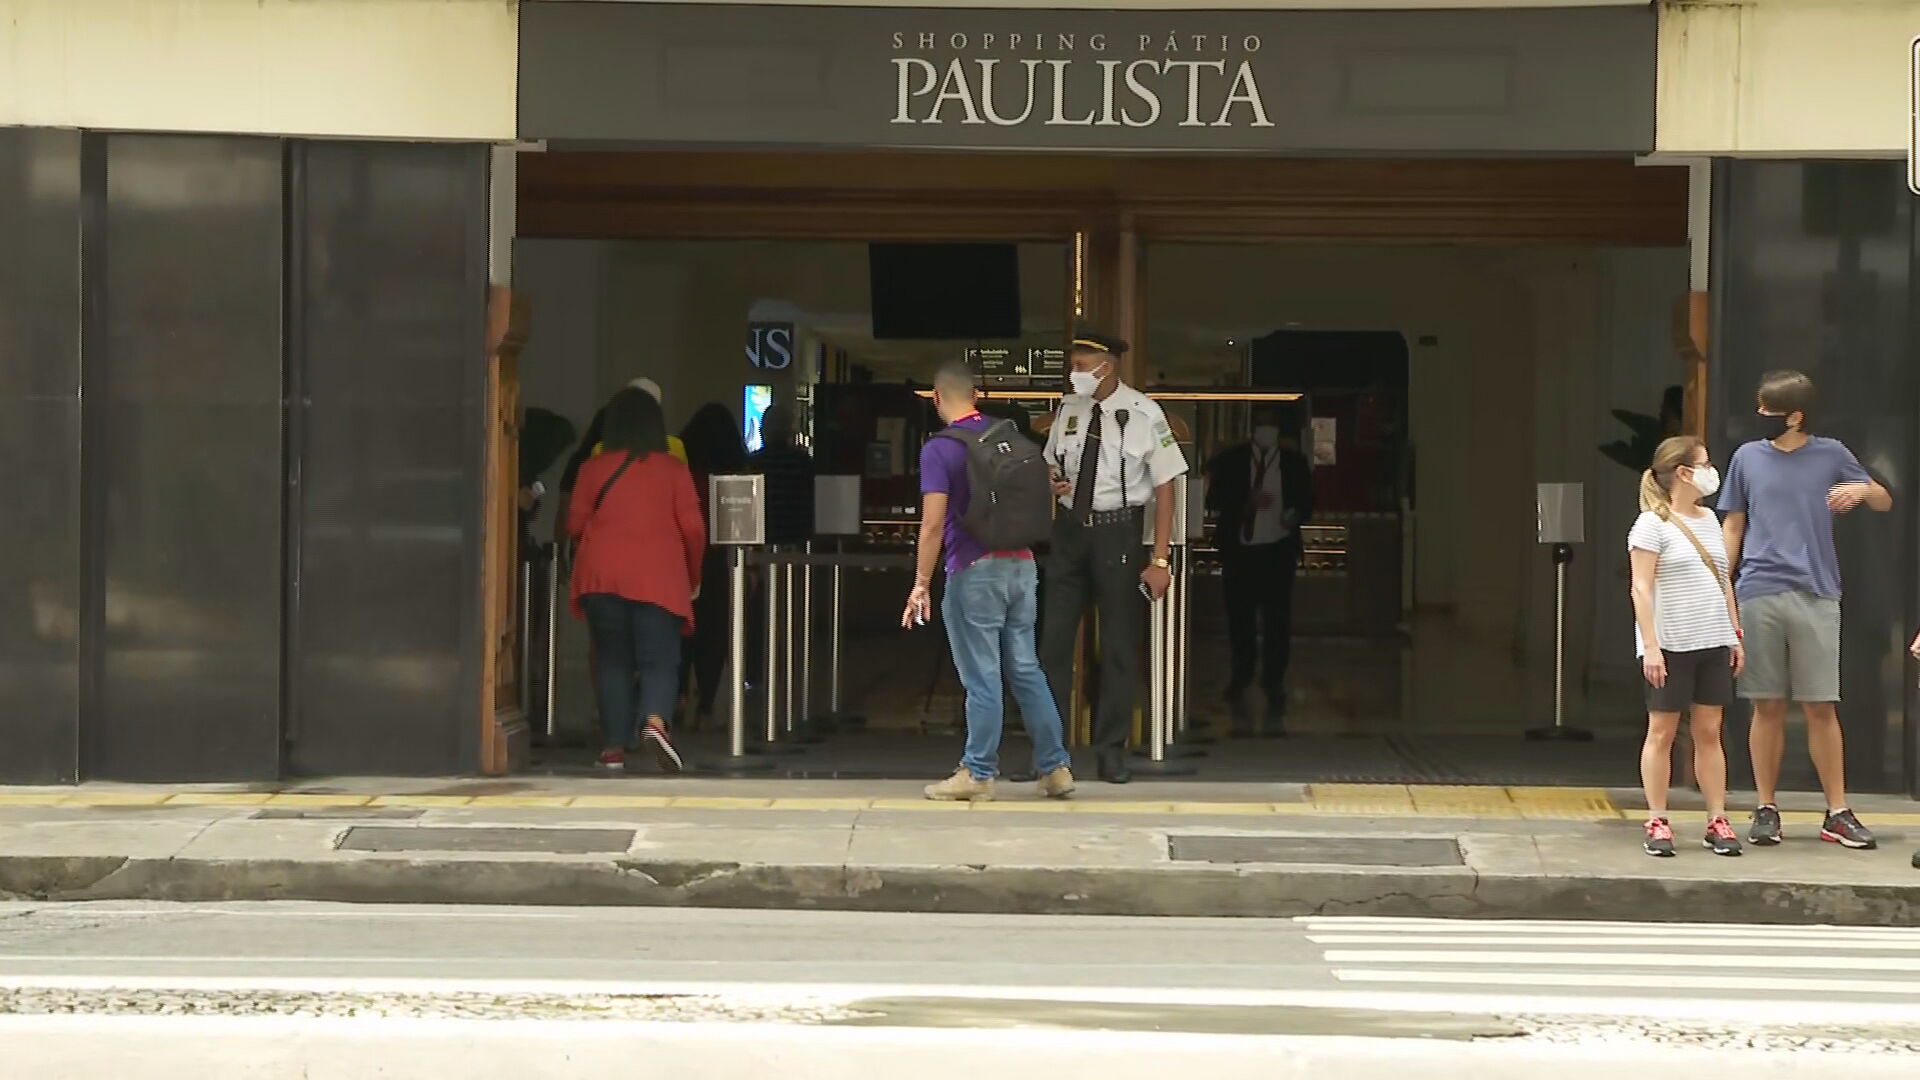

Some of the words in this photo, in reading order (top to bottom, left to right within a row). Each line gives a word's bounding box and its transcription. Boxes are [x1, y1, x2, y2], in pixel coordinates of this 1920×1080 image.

[891, 32, 1106, 51] SHOPPING
[1139, 30, 1262, 52] PÁTIO
[890, 57, 1275, 127] PAULISTA
